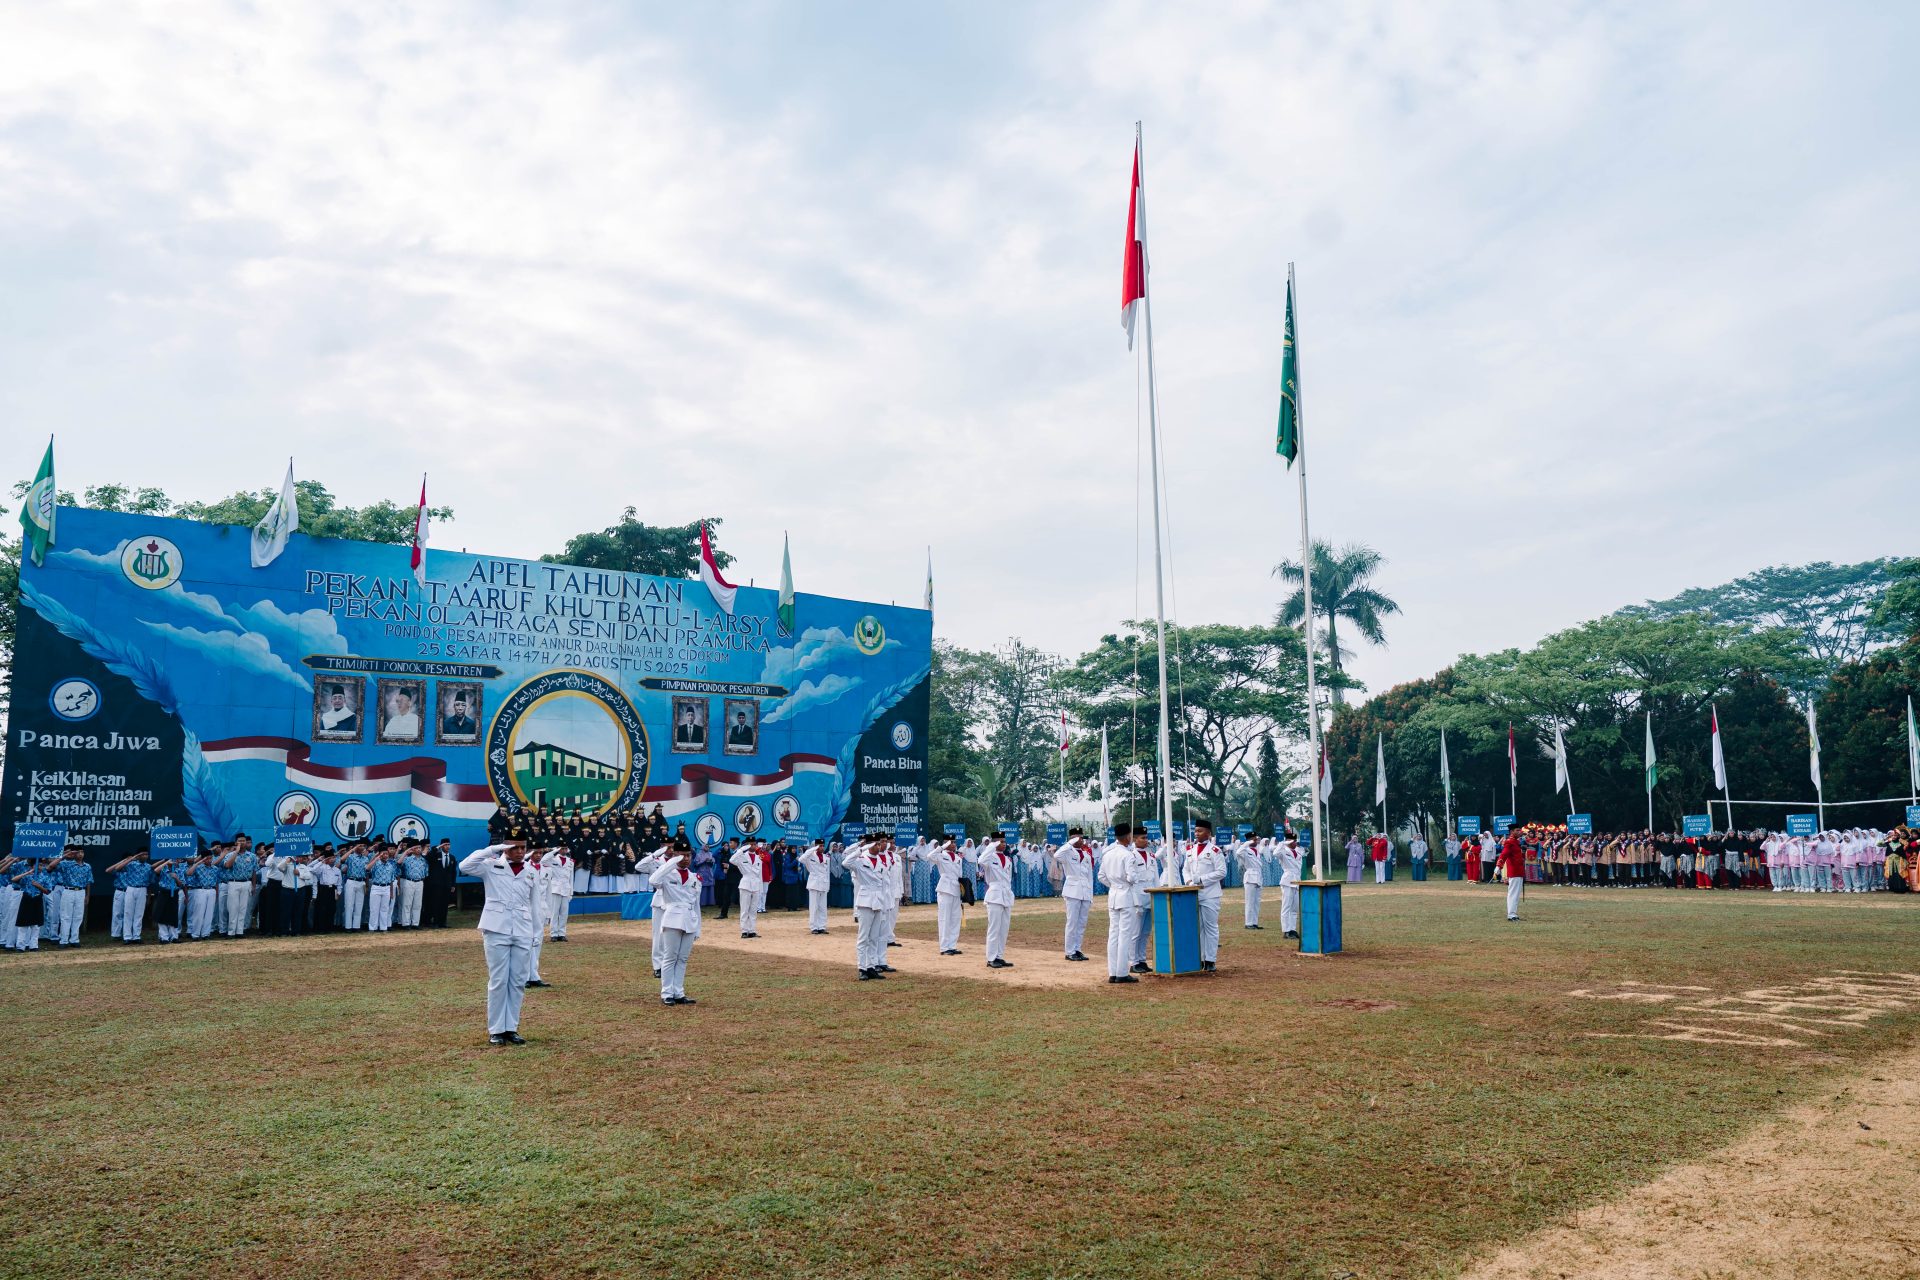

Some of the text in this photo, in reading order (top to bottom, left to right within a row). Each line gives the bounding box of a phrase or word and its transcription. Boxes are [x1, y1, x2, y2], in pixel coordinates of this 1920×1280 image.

[468, 559, 683, 604] APEL TAHUNAN
[305, 570, 409, 600] PEKAN
[425, 581, 533, 613] TA'ARUF
[327, 596, 771, 653] PEKAN OLAHRAGA SENI DAN PRAMUKA
[385, 623, 441, 640] PONDOK
[447, 628, 536, 648] PESANTREN
[540, 637, 582, 652] ANNUR
[586, 641, 663, 659] DARUNNAJAH
[678, 648, 730, 664] CIDOKOM
[418, 643, 440, 656] 25
[445, 643, 501, 660] SAFAR
[564, 654, 581, 666] 20
[585, 657, 652, 673] AGUSTUS
[656, 662, 688, 674] 2025
[695, 665, 707, 676] M
[326, 658, 483, 677] TRIMURTI PONDOK PESANTREN
[661, 680, 769, 695] PIMPINAN PONDOK PESANTREN
[18, 729, 162, 750] Panca Jiwa
[863, 755, 922, 770] Panca Bina
[29, 786, 153, 801] Kesederhanaan
[861, 783, 893, 797] Bertaqwa
[902, 794, 918, 804] Allah
[28, 801, 140, 816] Kemandirian
[899, 804, 918, 814] mulia
[864, 814, 918, 824] Berbadan sehat
[19, 828, 63, 838] KONSULAT
